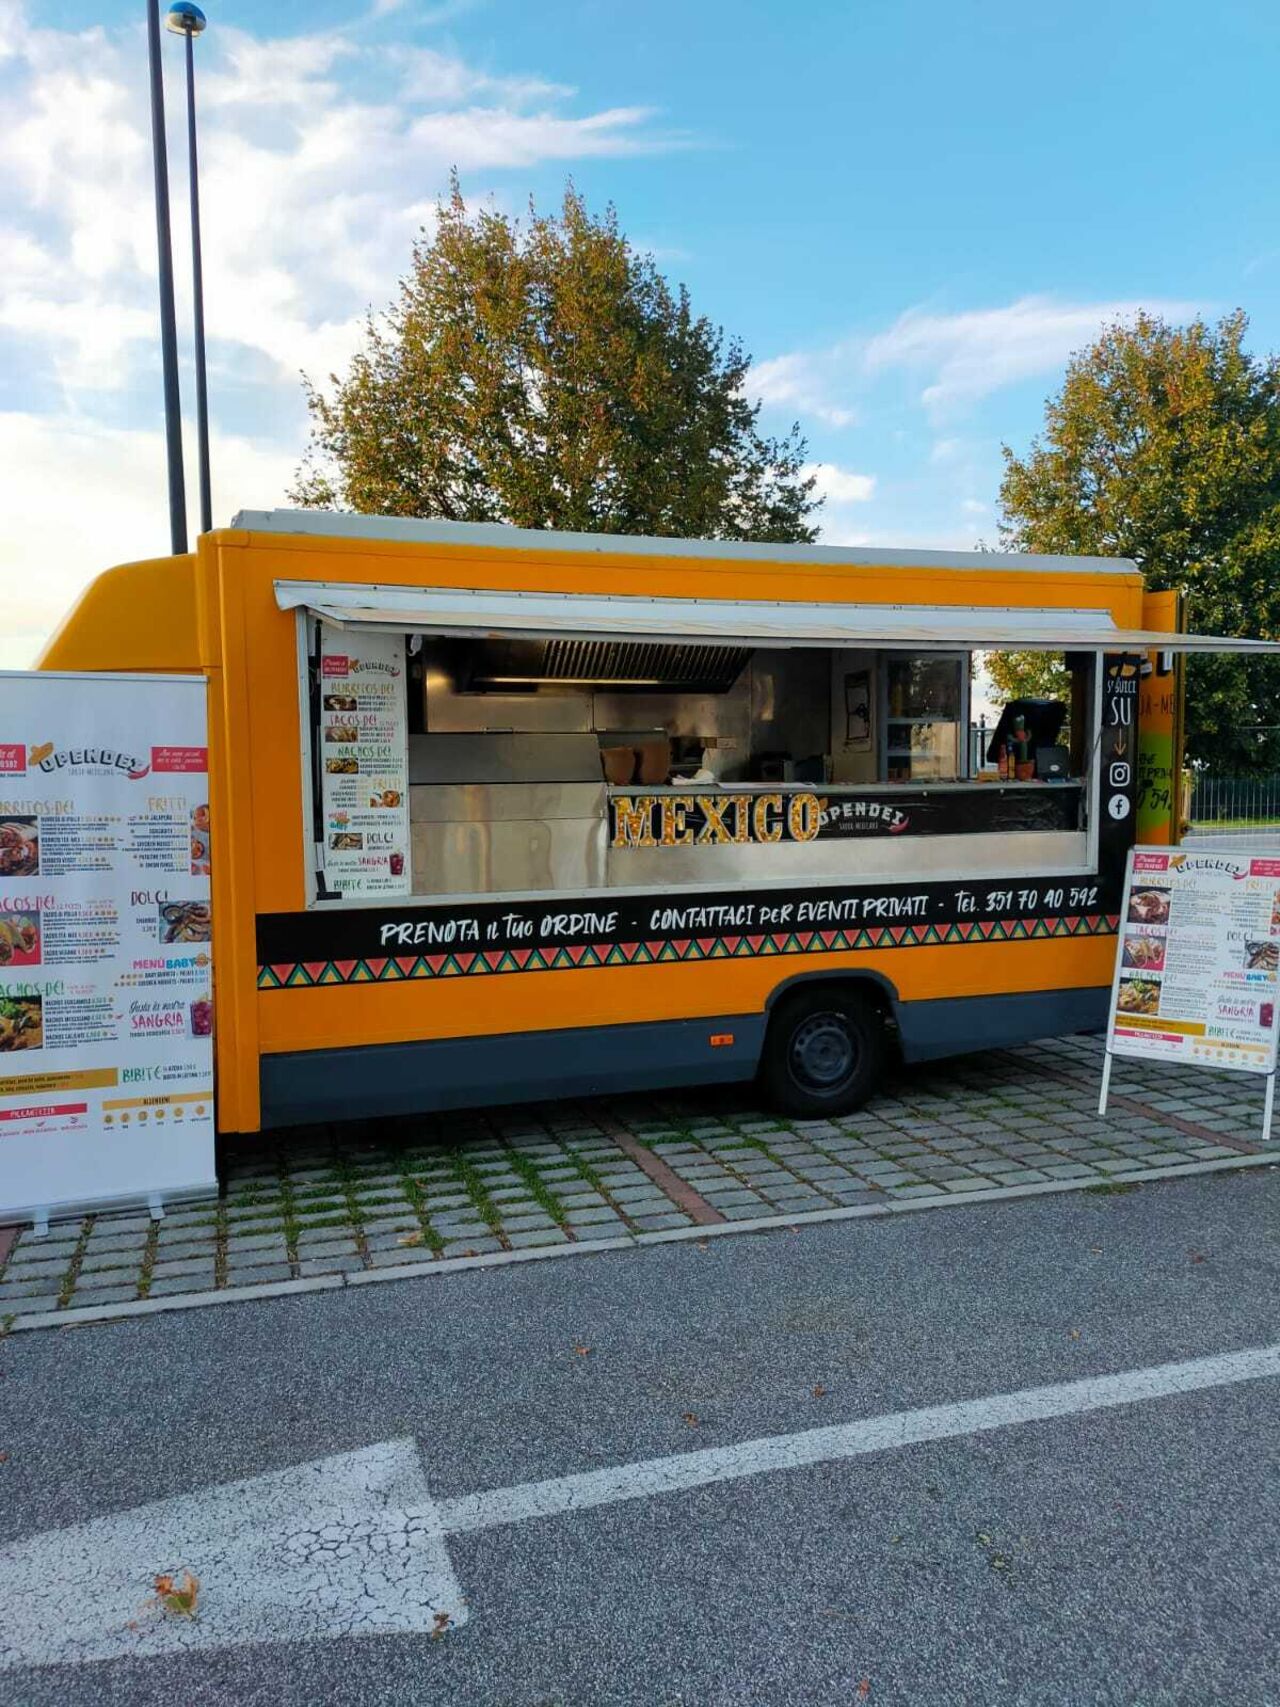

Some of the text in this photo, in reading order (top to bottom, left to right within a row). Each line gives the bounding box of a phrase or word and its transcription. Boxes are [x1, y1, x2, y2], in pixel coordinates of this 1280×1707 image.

[1111, 696, 1131, 726] SU
[611, 793, 820, 848] MEXICO
[380, 919, 480, 946] PRENOTA
[540, 911, 618, 937] ORDINE
[650, 904, 755, 931] CONTATTACI
[797, 898, 860, 923] EVENTI
[863, 895, 930, 919] PRIVATI
[985, 890, 1014, 912] 351
[1018, 889, 1038, 910] 70
[1043, 888, 1064, 908] 40
[1069, 886, 1098, 907] 592
